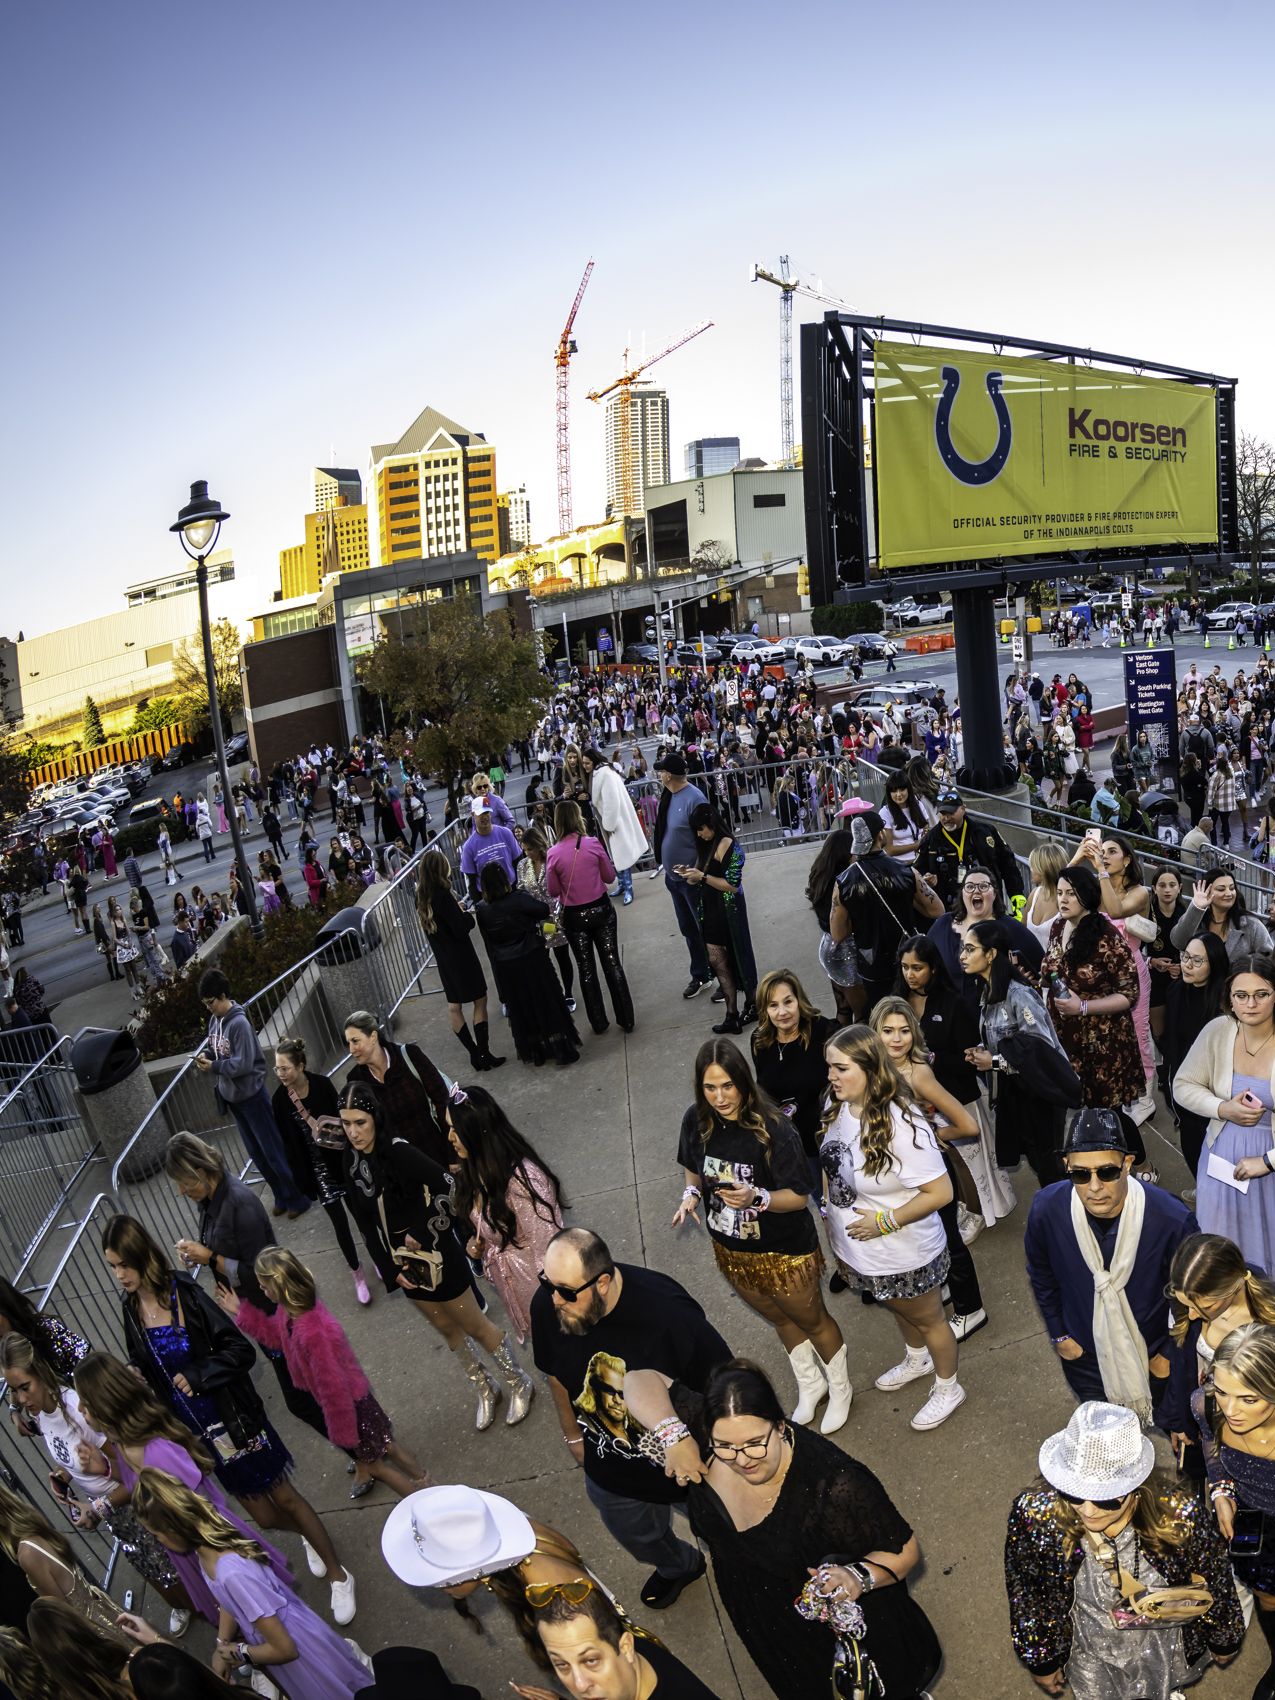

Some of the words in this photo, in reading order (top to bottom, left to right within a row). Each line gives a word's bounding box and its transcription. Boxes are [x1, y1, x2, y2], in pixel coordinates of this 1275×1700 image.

[1068, 408, 1187, 448] Koorsen
[1069, 444, 1100, 458] FIRE
[1108, 446, 1118, 459] &
[1125, 447, 1187, 463] SECURITY
[953, 514, 997, 528] OFFICIAL
[1000, 513, 1042, 526] SECURITY
[1045, 512, 1085, 524] PROVIDER
[1088, 512, 1092, 522] &
[1095, 512, 1111, 521] FIRE
[1113, 511, 1153, 521] PROTECTION
[1156, 511, 1179, 520] EXPERT
[1024, 529, 1035, 539] OF
[1038, 528, 1053, 538] THE
[1056, 526, 1110, 537] INDIANAPOLIS
[1112, 524, 1134, 535] COLTS
